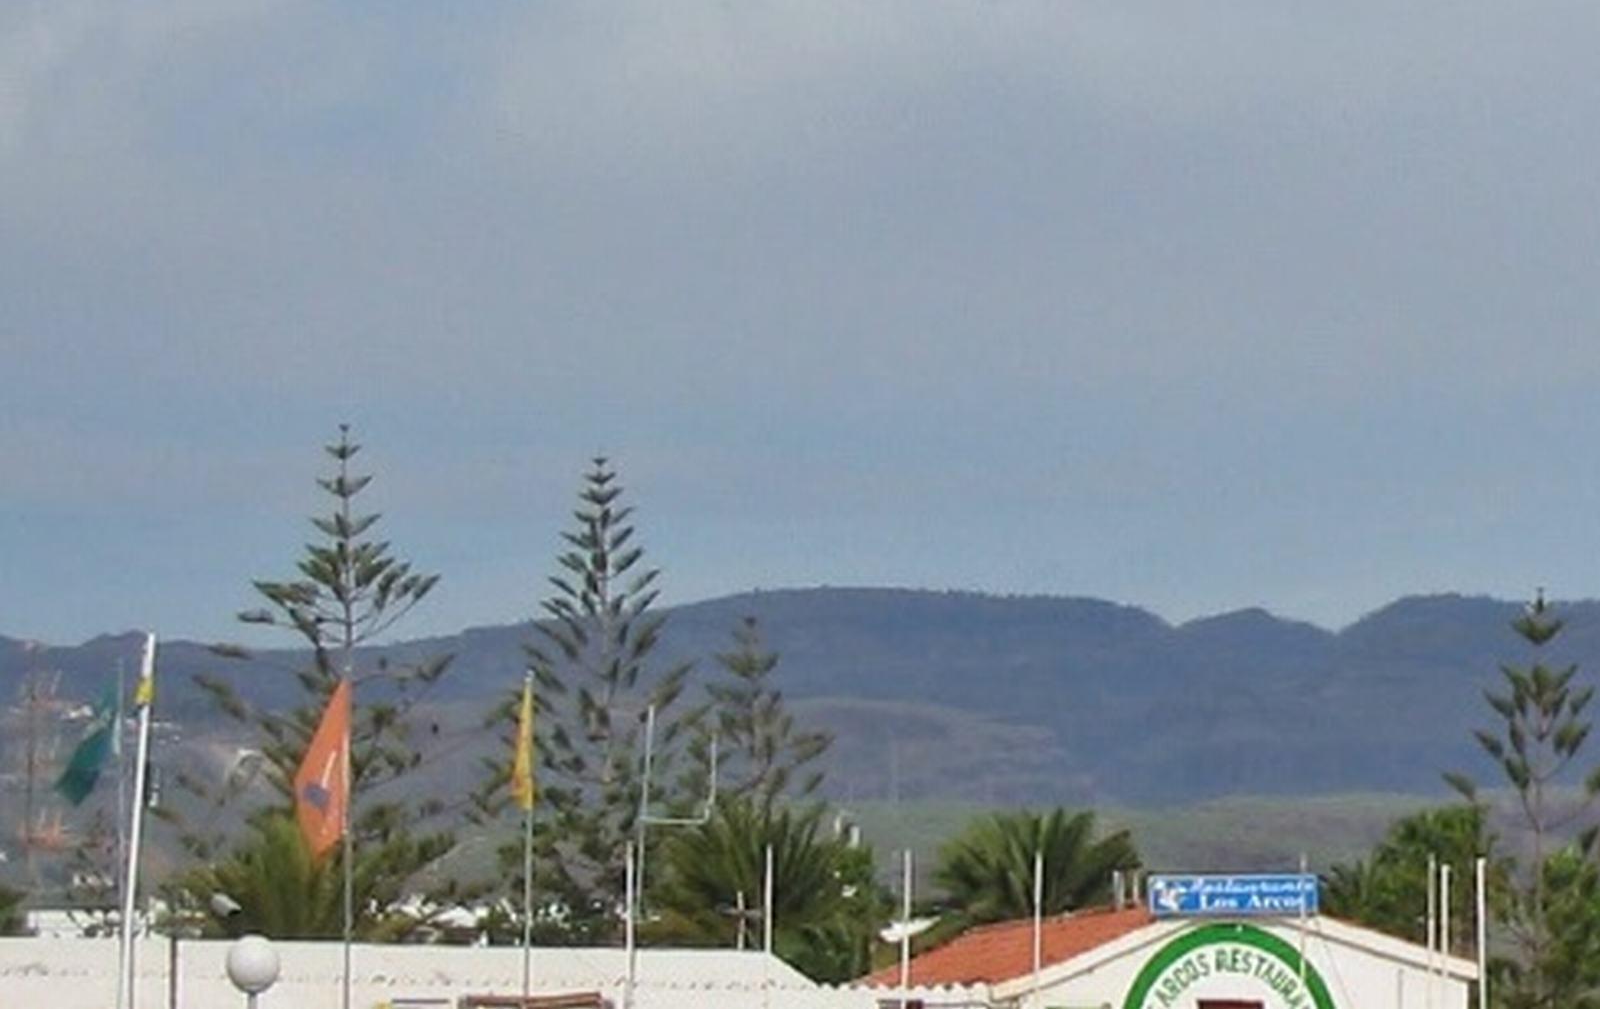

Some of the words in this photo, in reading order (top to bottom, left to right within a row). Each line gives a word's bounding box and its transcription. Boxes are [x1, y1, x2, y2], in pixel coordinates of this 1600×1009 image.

[1201, 894, 1238, 910] Los
[1154, 953, 1211, 1009] ARCOS
[1215, 948, 1310, 1009] RESTAURA
